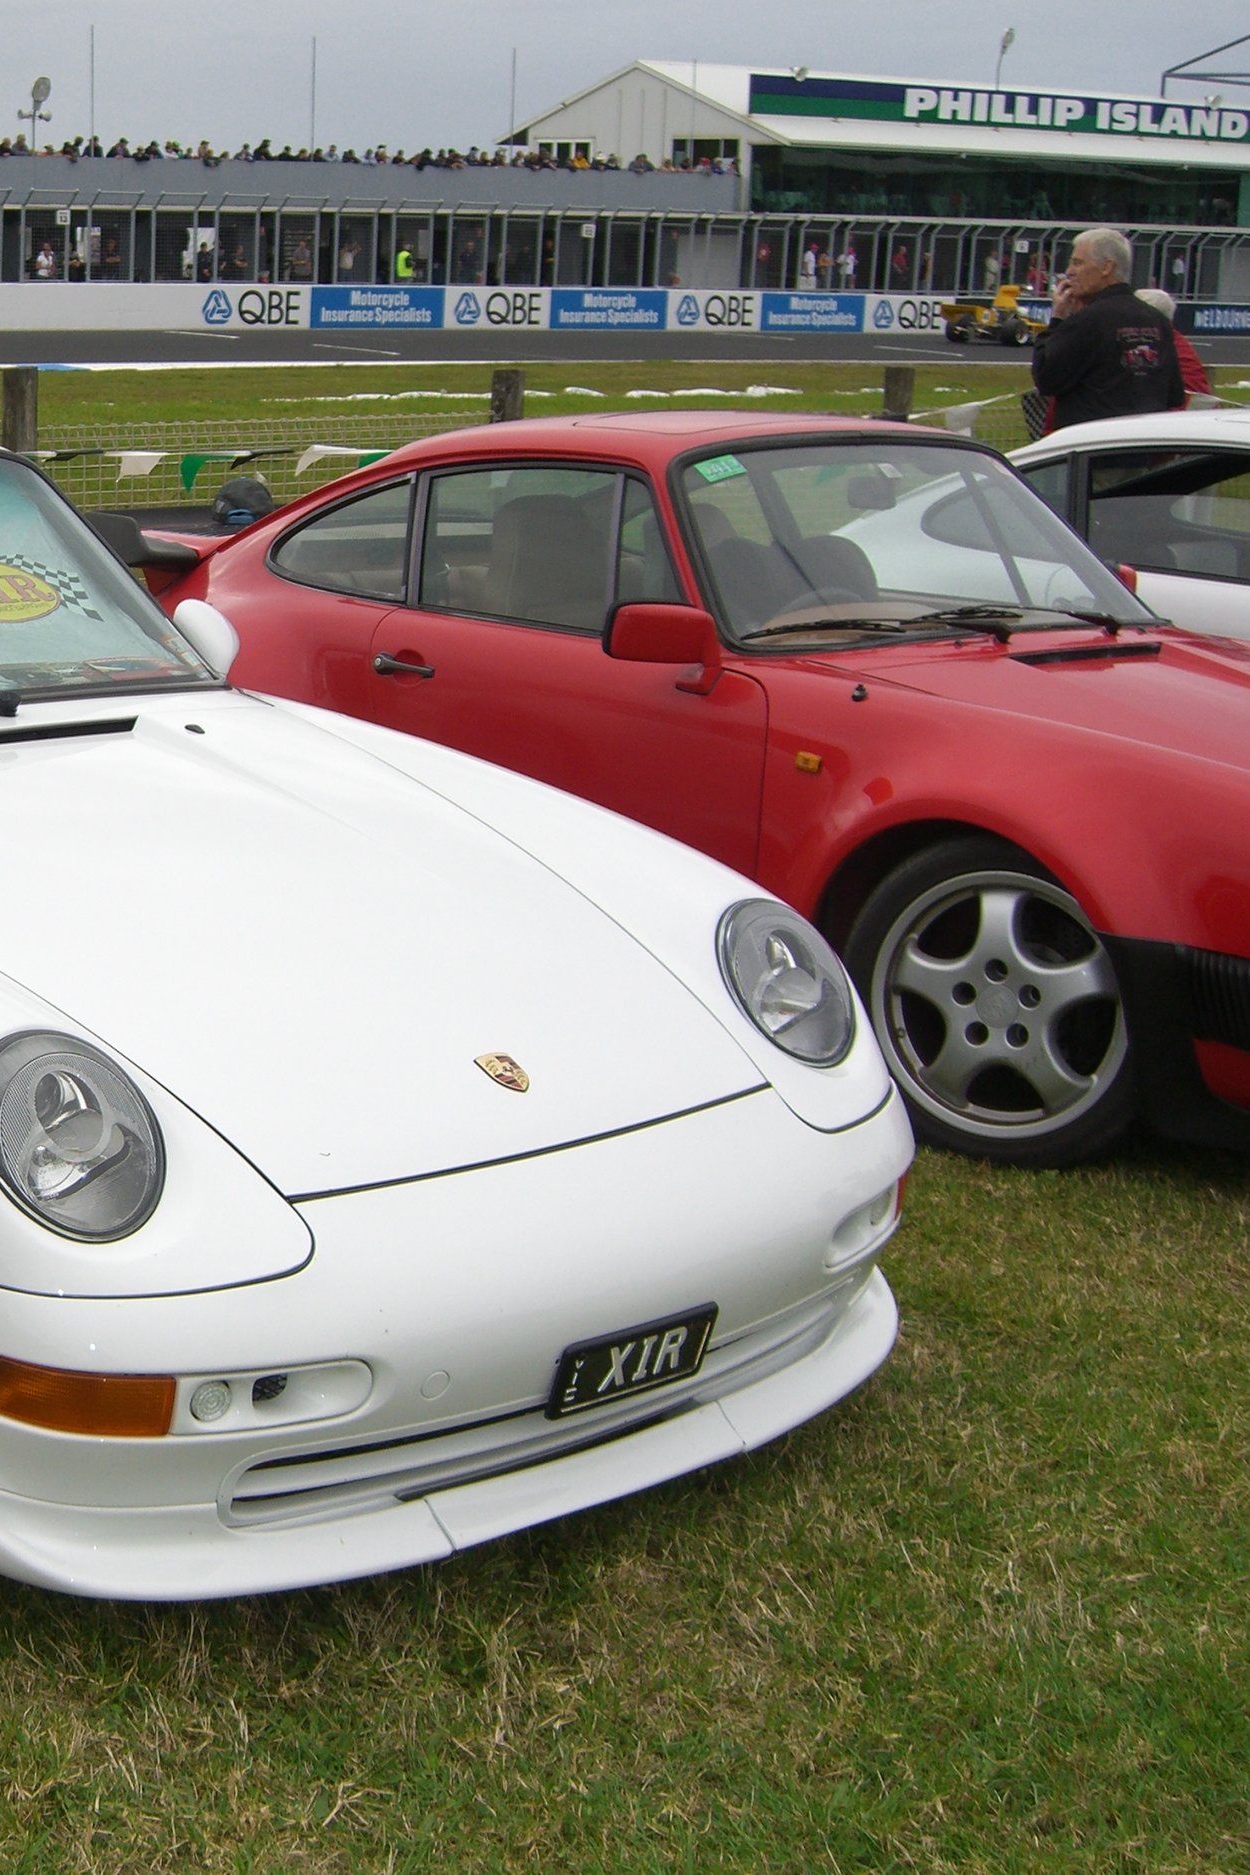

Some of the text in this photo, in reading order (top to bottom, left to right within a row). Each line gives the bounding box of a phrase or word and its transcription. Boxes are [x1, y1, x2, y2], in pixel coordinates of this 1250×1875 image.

[903, 88, 1248, 138] PHILLIP ISLAND
[238, 290, 300, 325] QBE
[351, 290, 410, 307] Motorcycle
[486, 292, 541, 325] QBE
[584, 293, 636, 309] Motorcycle
[705, 295, 754, 326] QBE
[321, 307, 432, 323] Insurance Specialists
[559, 309, 658, 324] Insurance Specialists
[899, 300, 941, 329] QBE
